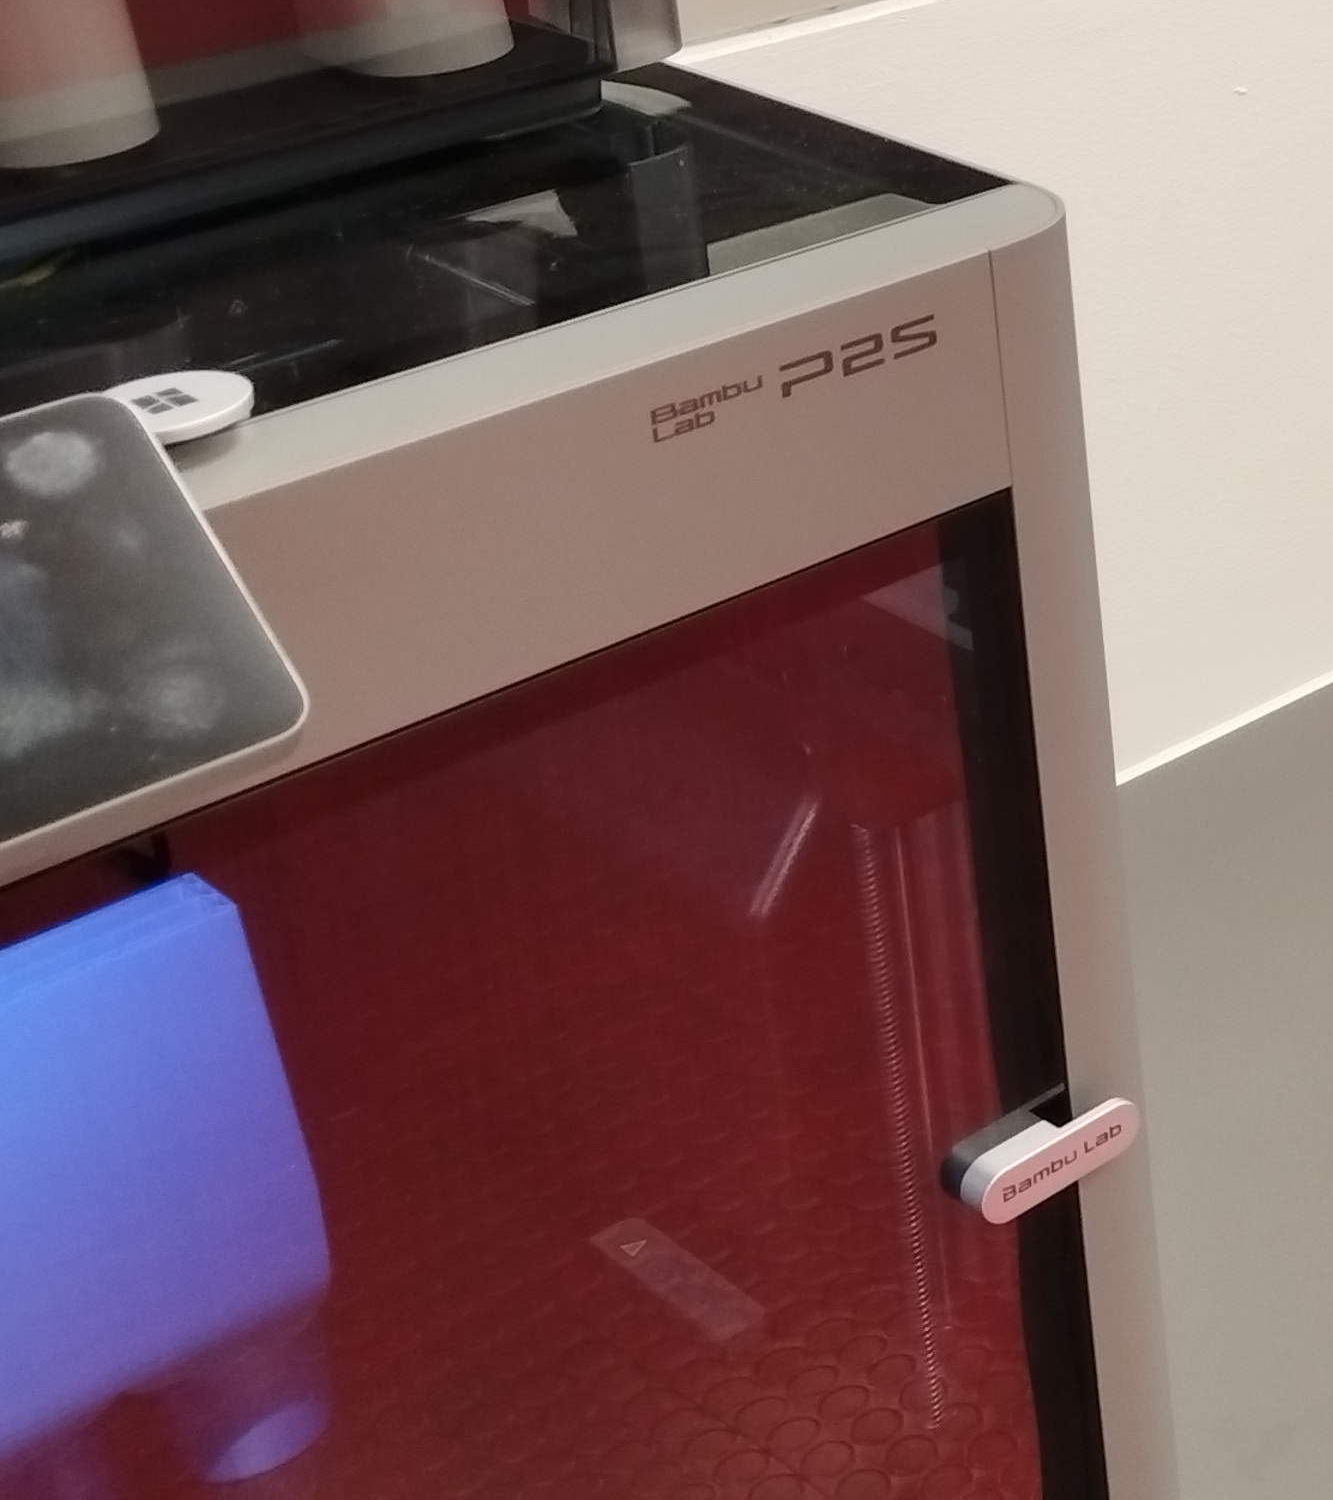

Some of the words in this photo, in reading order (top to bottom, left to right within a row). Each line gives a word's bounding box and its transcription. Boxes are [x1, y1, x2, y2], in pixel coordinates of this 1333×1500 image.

[779, 314, 937, 398] P2S
[650, 375, 763, 426] Bambu
[652, 411, 716, 443] Lab
[1001, 1149, 1078, 1203] Bambu
[1083, 1124, 1123, 1153] Lab
